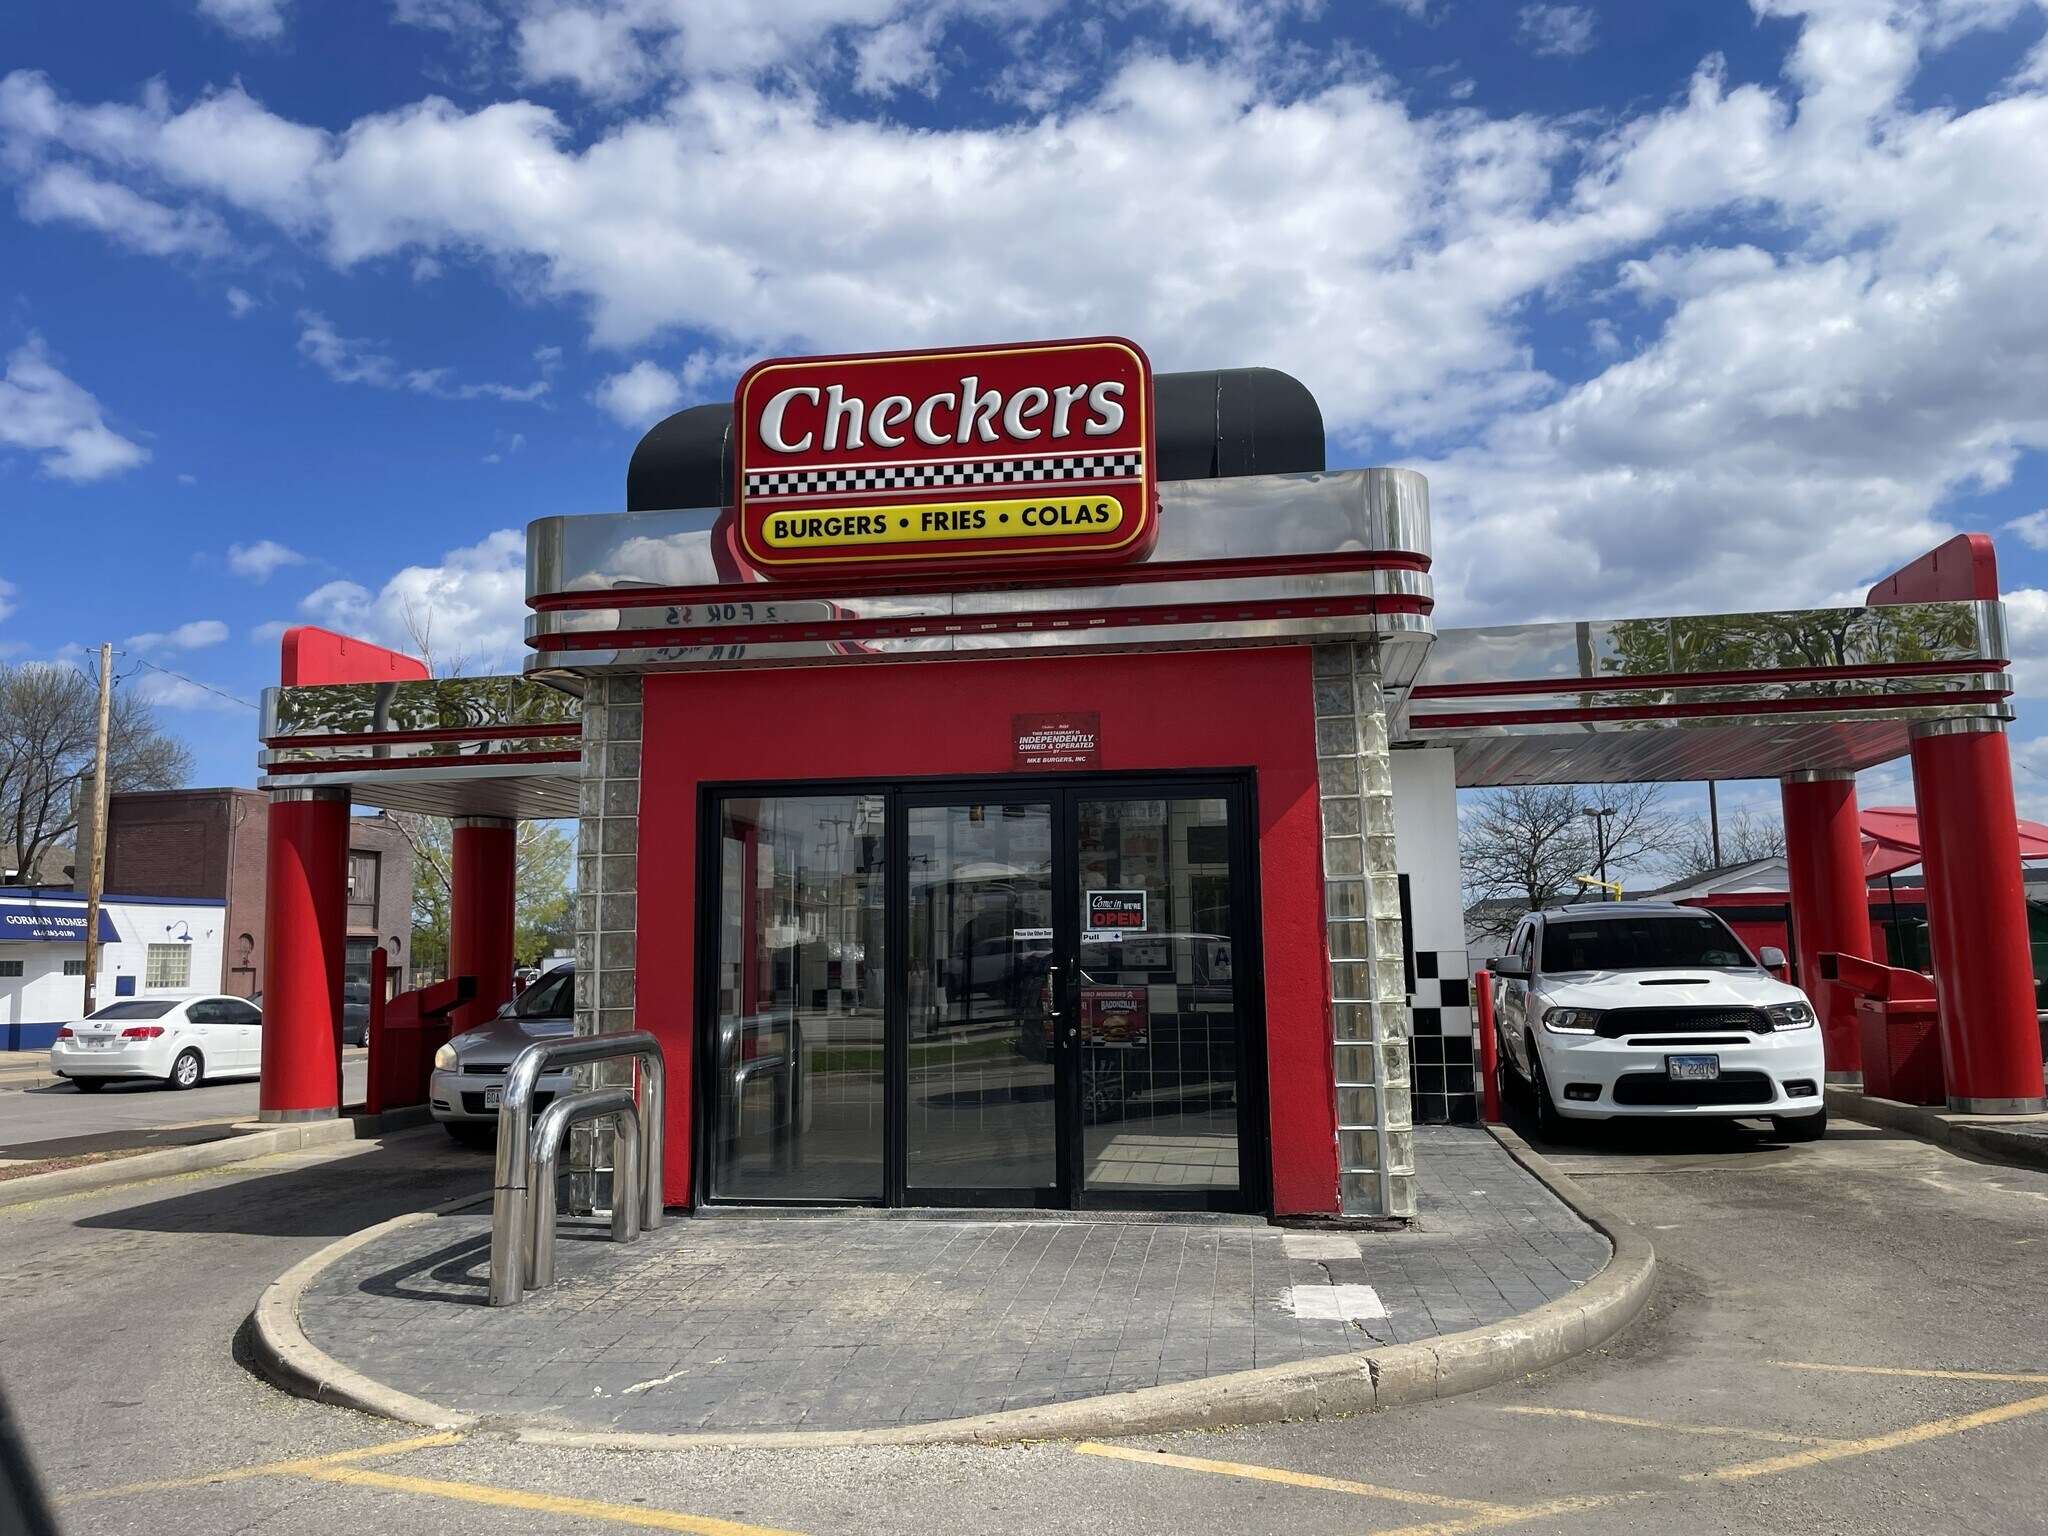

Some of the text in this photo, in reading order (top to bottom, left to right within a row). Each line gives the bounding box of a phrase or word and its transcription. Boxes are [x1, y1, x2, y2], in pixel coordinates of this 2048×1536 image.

[759, 376, 1125, 453] Checkers
[774, 504, 1110, 539] BURGERS FRIES COLAS
[1019, 734, 1094, 744] INDEPENDENTLY
[1092, 895, 1142, 910] Come in WE'RE
[6, 915, 88, 927] GORMAN HOMES
[1093, 912, 1141, 926] OPEN
